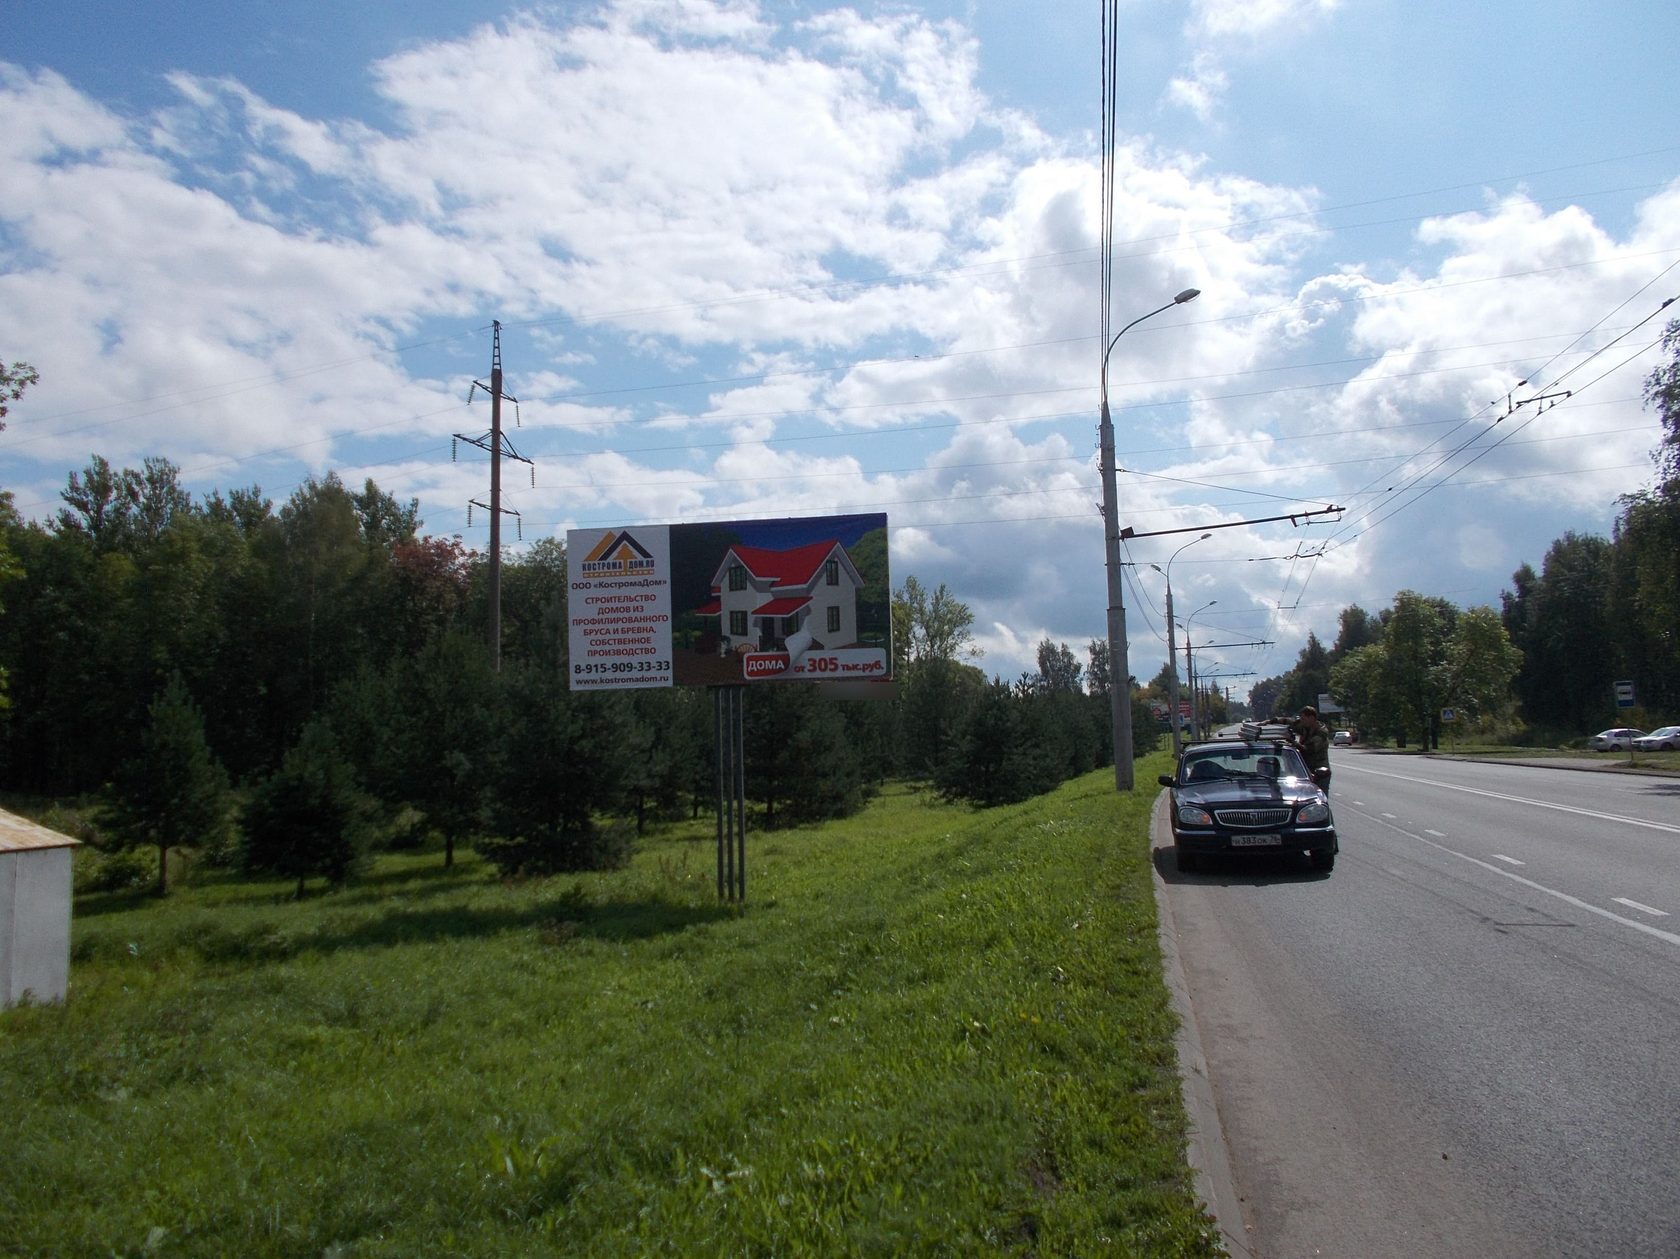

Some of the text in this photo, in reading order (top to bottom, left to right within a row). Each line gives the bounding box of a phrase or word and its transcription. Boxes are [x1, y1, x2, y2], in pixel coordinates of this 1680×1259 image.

[582, 562, 622, 571] КОСТРОМА
[571, 579, 667, 590] ООО «КостромаДом»
[585, 594, 656, 605] СТРОИТЕЛЬСТВО
[597, 605, 644, 616] ДОМОВ ИЗ
[572, 615, 669, 626] ПРОФИЛИРОВАННОГО
[583, 628, 611, 636] БРУСА
[590, 637, 652, 646] СОБСТВЕННОЕ
[587, 647, 656, 657] ПРОИЗВОДСТВО
[574, 661, 670, 674] 8-915-909-33-33
[748, 657, 884, 673] ДОМА от 305 тыс.руб.
[576, 674, 669, 685] www.kostromadom.ru
